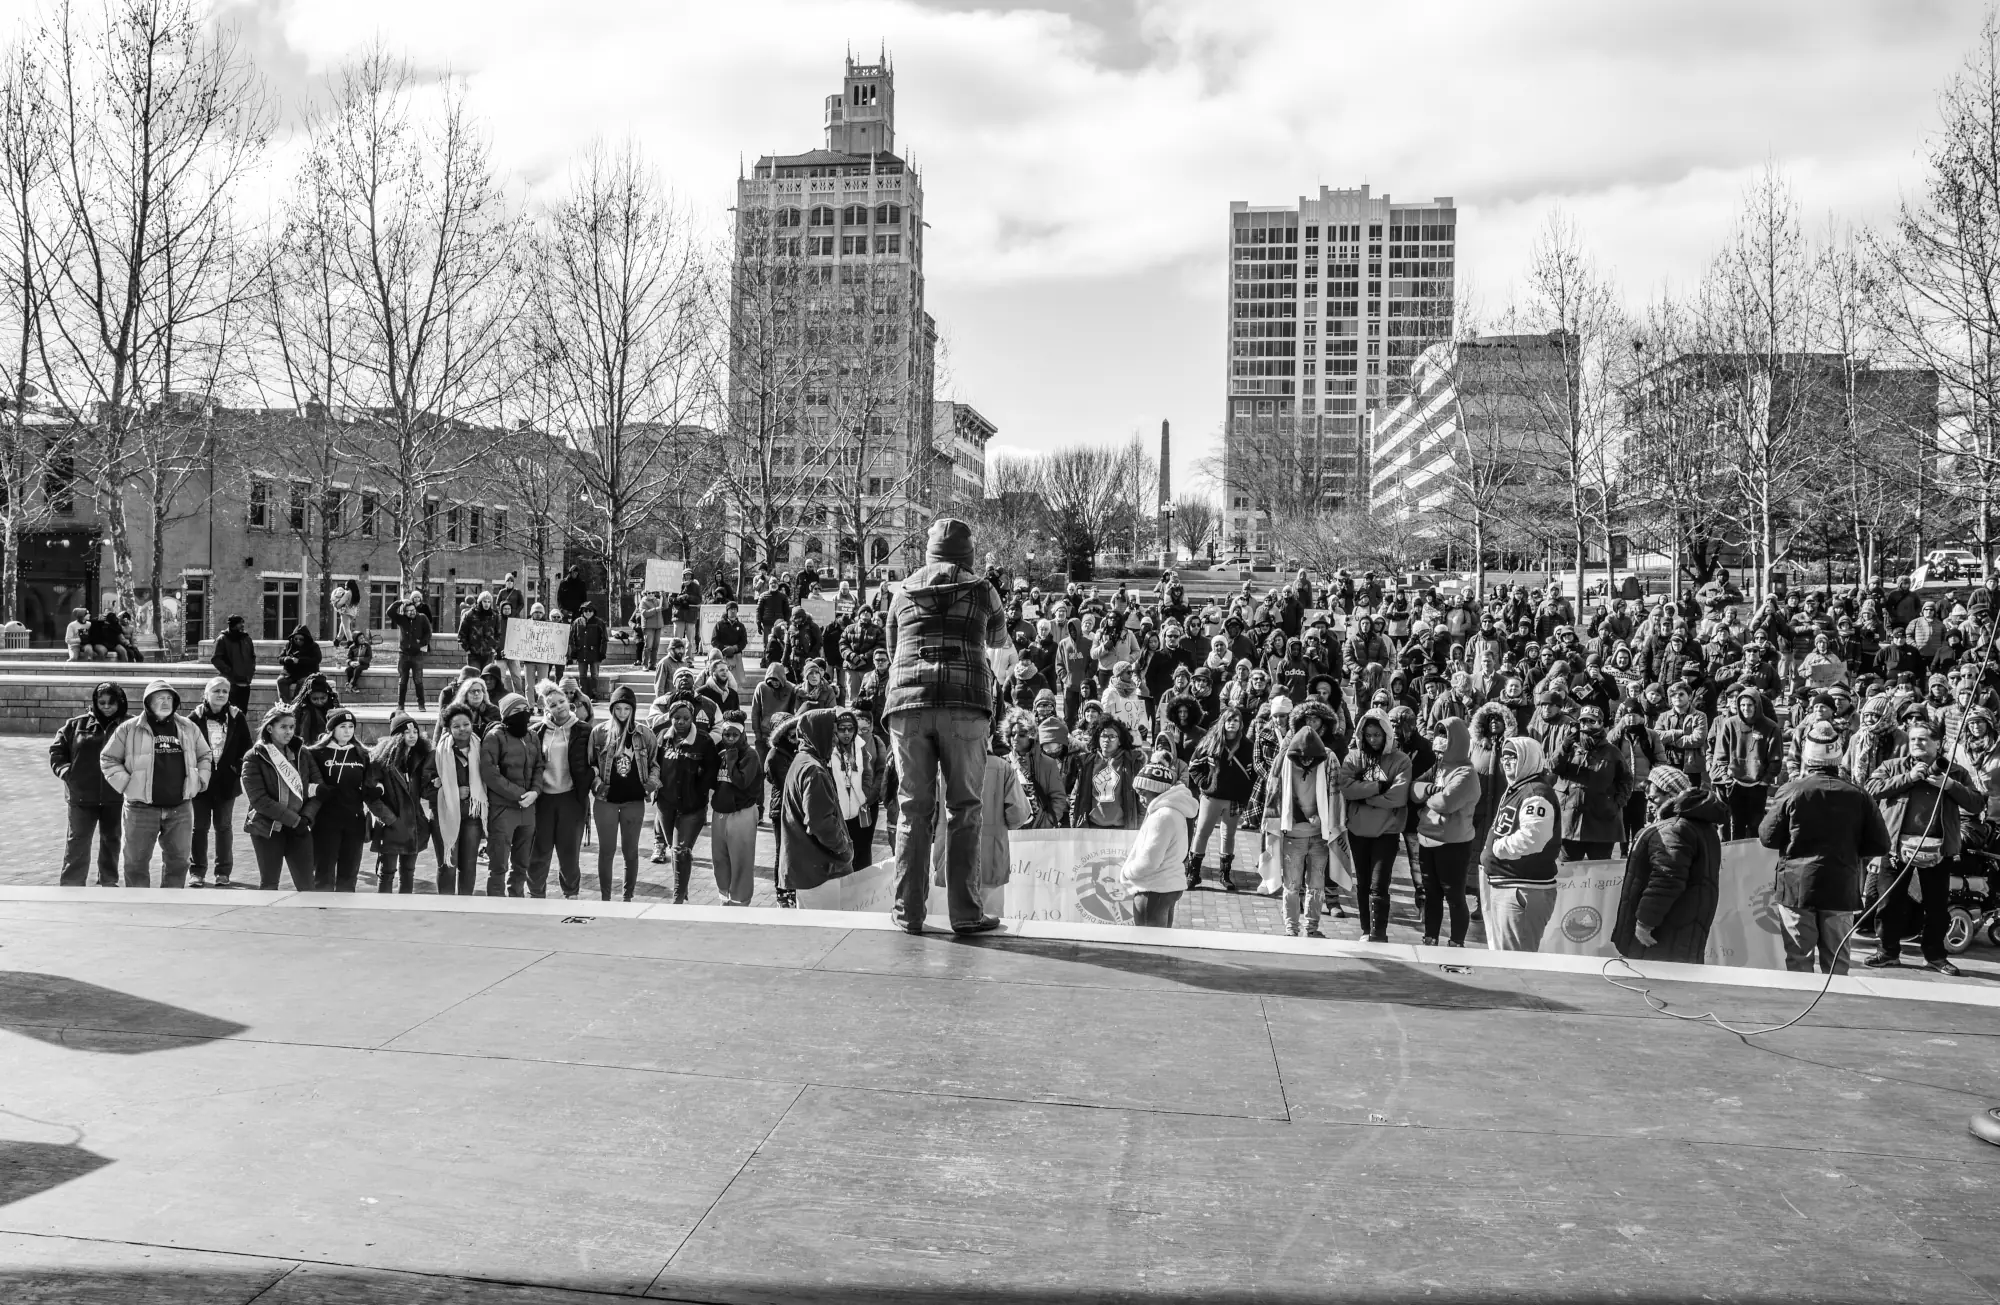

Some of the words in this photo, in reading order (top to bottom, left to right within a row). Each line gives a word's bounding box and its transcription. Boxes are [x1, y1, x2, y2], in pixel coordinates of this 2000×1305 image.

[1580, 707, 1600, 716] LOVE
[278, 761, 291, 777] MISS
[325, 760, 364, 768] Champion
[1526, 805, 1545, 817] 20
